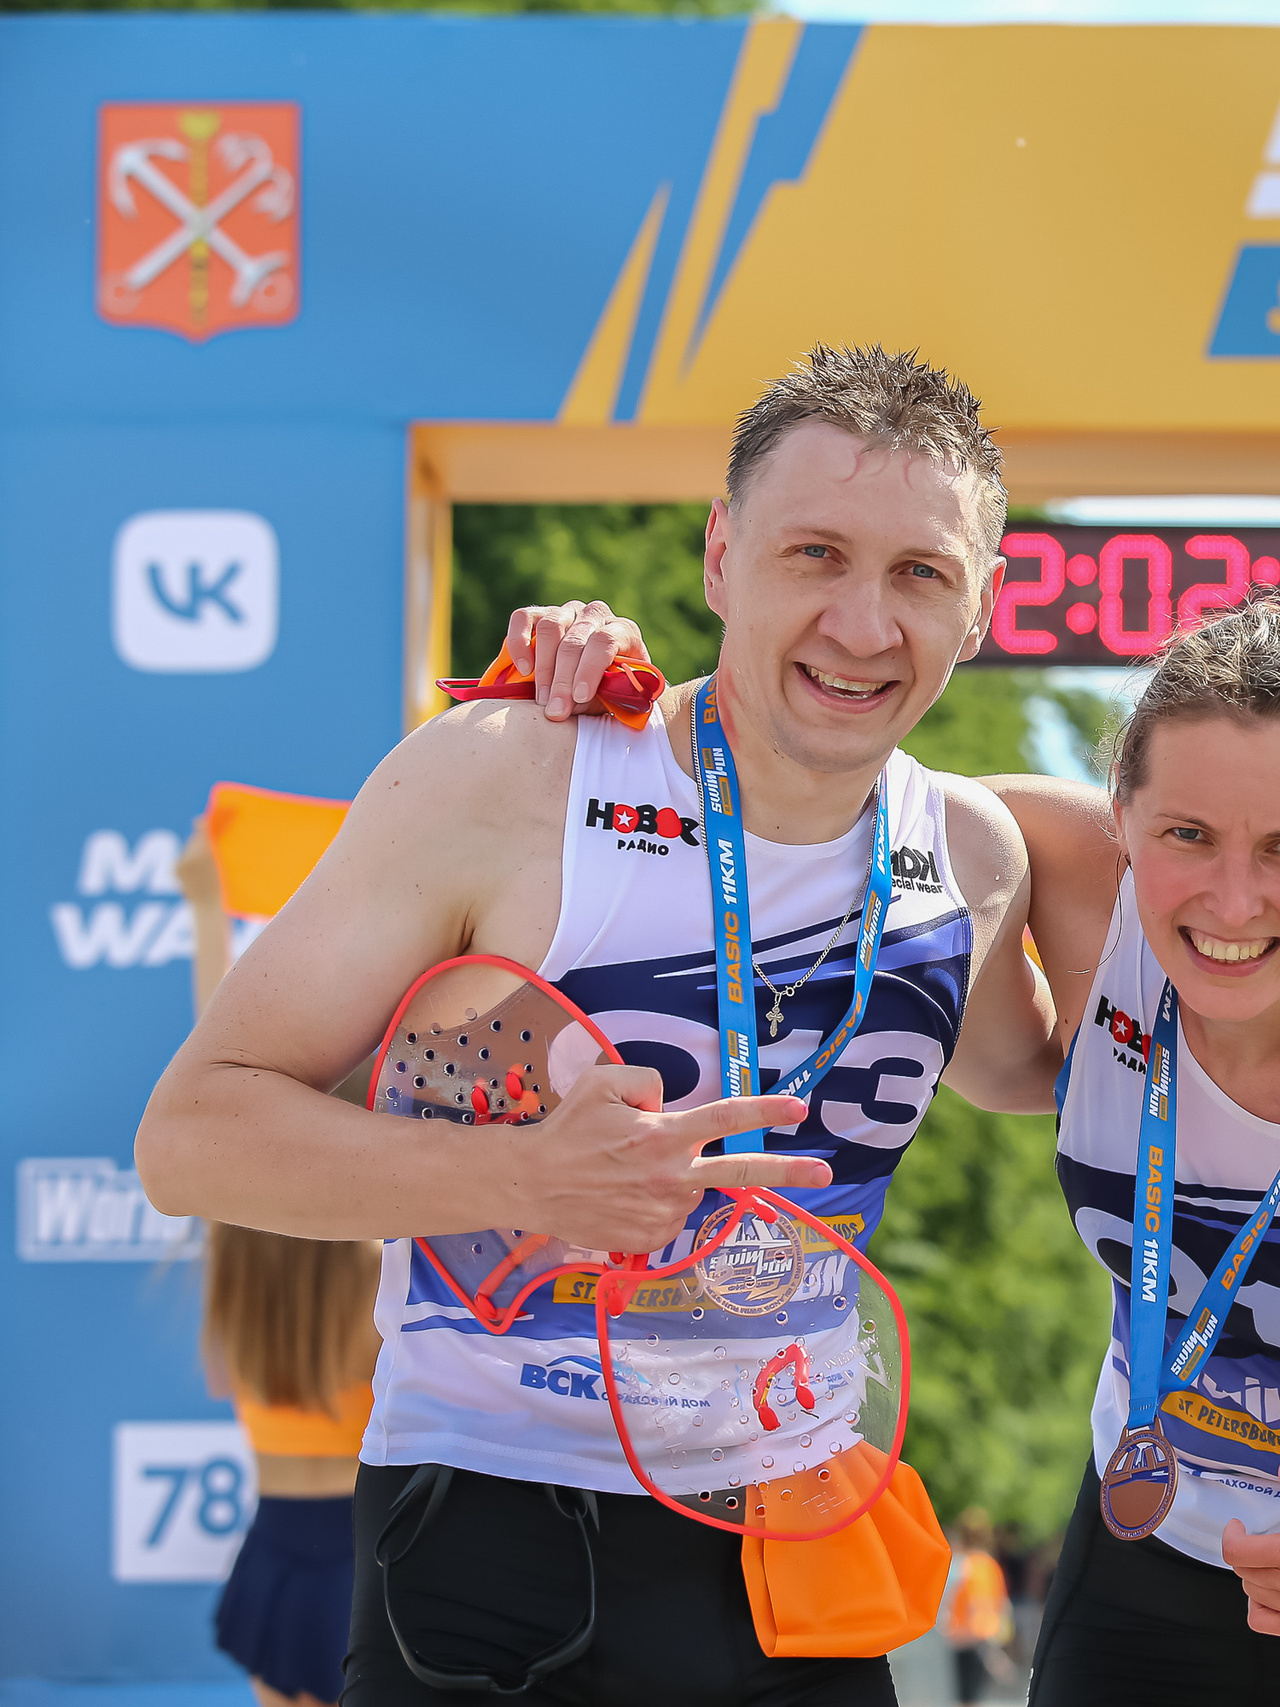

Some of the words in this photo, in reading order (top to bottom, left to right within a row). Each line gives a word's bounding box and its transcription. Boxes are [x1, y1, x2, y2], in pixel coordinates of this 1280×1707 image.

[146, 560, 246, 626] VK
[78, 828, 184, 895] M
[617, 838, 670, 856] РАДИО
[717, 838, 738, 905] 11KM
[724, 911, 743, 1004] BASIC
[1145, 1145, 1164, 1233] BASIC
[1142, 1238, 1159, 1303] 11KM
[1221, 1211, 1269, 1291] BASIC
[520, 1363, 600, 1400] ВСК
[681, 1398, 711, 1409] ДОМ
[140, 1456, 244, 1548] 78
